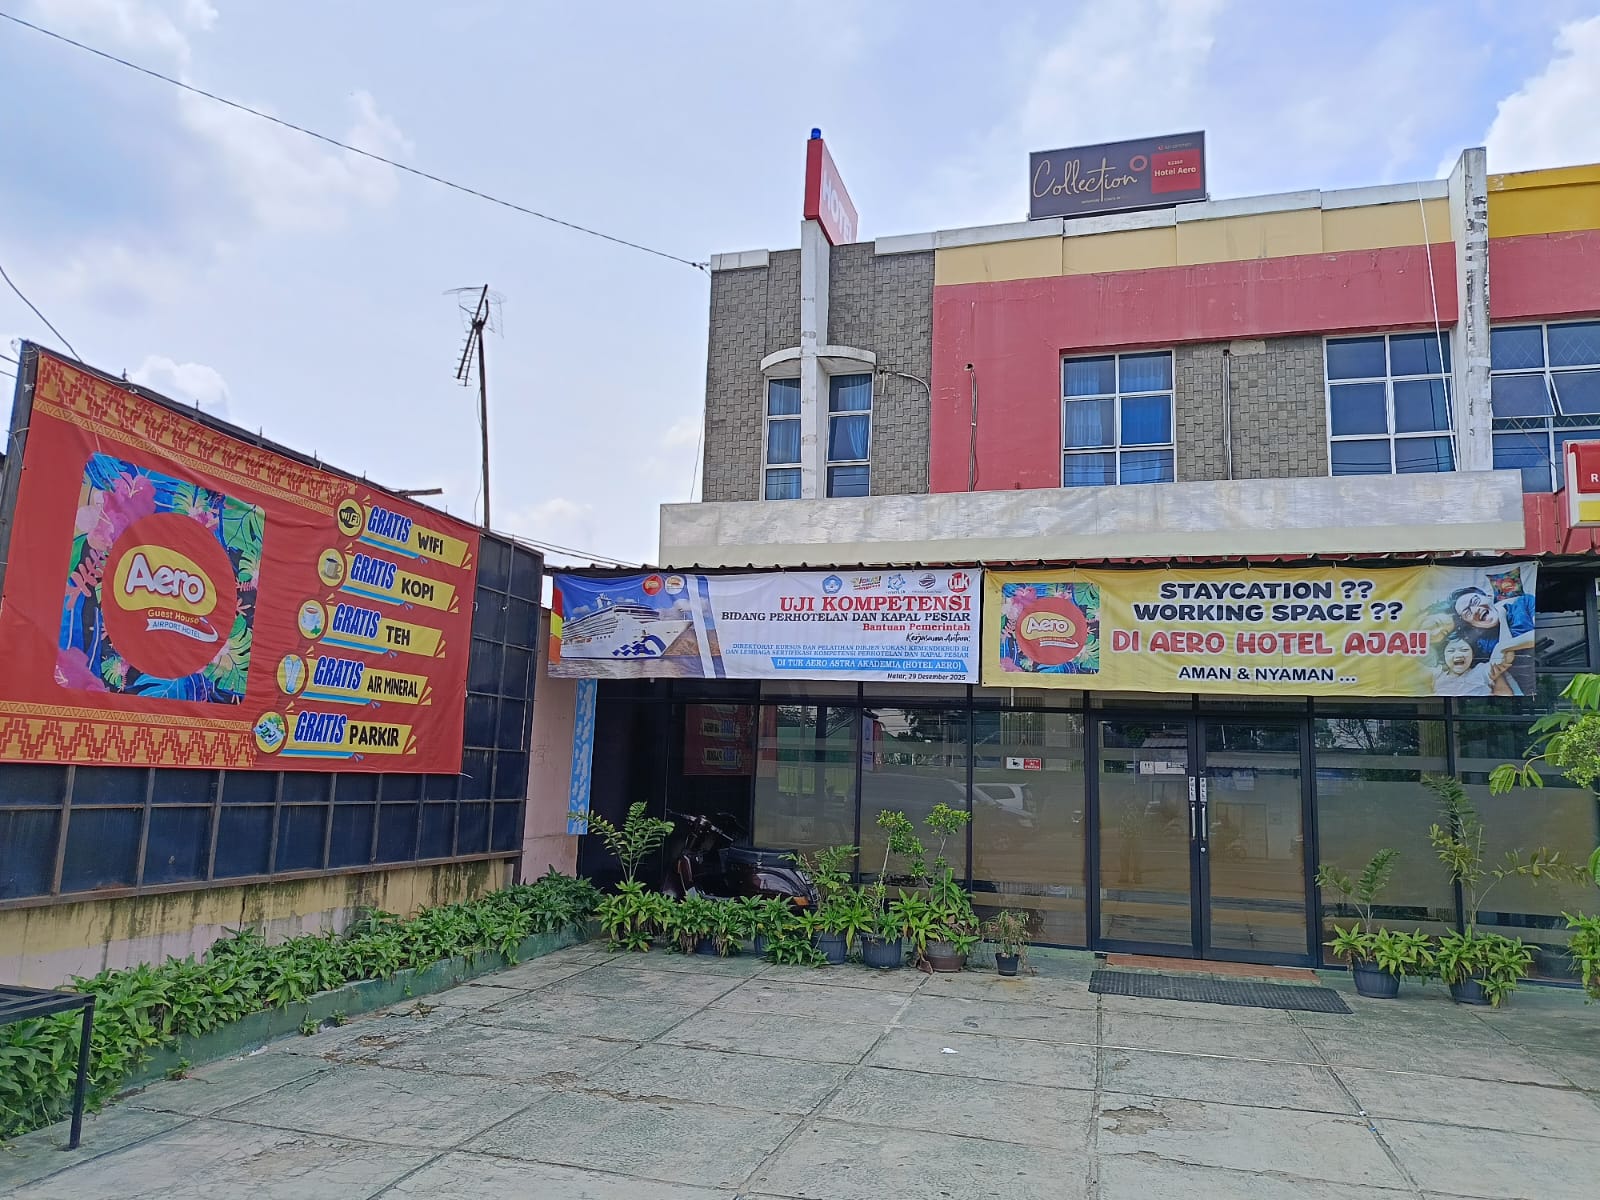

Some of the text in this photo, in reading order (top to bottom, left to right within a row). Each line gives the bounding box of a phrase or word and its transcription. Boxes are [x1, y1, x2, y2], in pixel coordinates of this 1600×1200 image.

[1033, 159, 1138, 202] Collection
[1154, 166, 1197, 177] Hotel Aero
[367, 505, 444, 556] GRATIS WIFI
[125, 552, 205, 604] Aero
[350, 552, 434, 602] GRATIS KOPI
[1160, 581, 1373, 600] STAYCATION ??
[780, 595, 971, 612] UJI KOMPETENSI
[1133, 602, 1403, 622] WORKING SPACE ??
[147, 608, 200, 625] Guest House
[332, 602, 411, 647] GRATIS TEH
[721, 612, 971, 622] BIDANG PERHOTELAN DAN KAPAL PESIAR
[1026, 616, 1069, 635] Aero
[152, 620, 201, 639] AIRPORT HOTEL
[863, 622, 970, 631] Bantuan Pemerintah
[1112, 630, 1427, 655] DI AERO HOTEL AJA!!
[788, 659, 804, 667] TUK
[806, 659, 828, 668] AERO
[829, 660, 855, 668] ASTRA
[857, 660, 901, 669] AKADEMIA
[902, 660, 934, 670] (HOTEL
[935, 661, 961, 671] AERO)
[1178, 666, 1231, 680] AMAN
[1237, 667, 1250, 680] &
[1255, 668, 1334, 681] NYAMAN
[312, 655, 419, 698] GRATIS AIR MINERAL
[293, 711, 399, 747] GRATIS PARKIR
